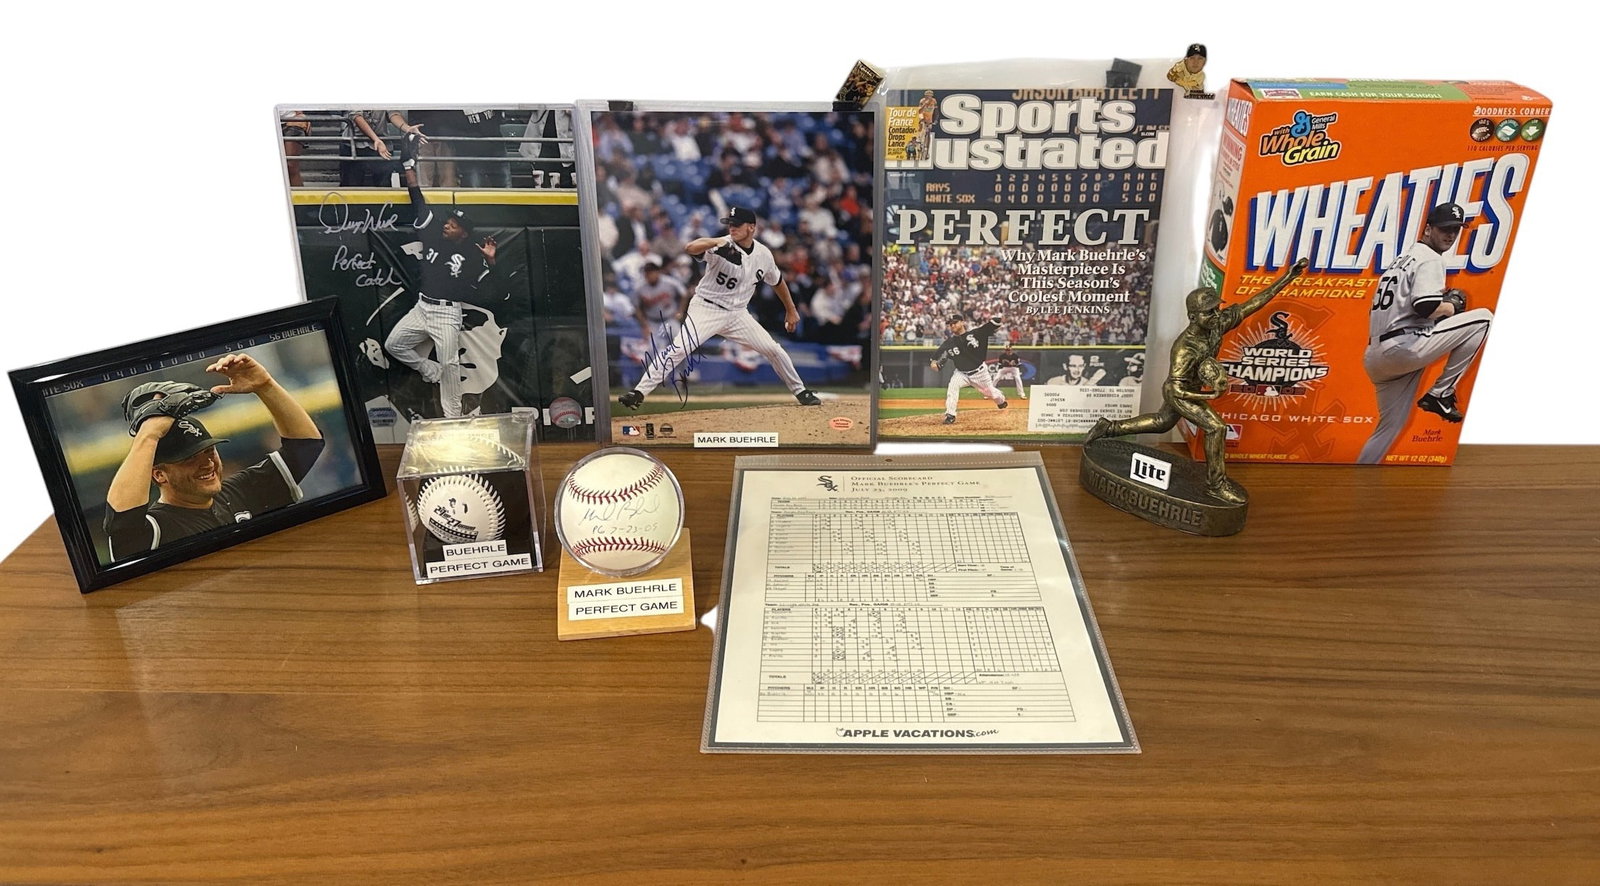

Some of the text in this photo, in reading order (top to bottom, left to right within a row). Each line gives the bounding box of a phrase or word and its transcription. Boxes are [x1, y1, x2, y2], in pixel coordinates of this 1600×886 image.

[889, 107, 917, 118] Tour de
[939, 93, 1137, 139] Sports
[1519, 107, 1551, 116] CORNER
[888, 117, 914, 127] France
[1311, 113, 1336, 124] General
[1273, 126, 1290, 136] with
[1311, 122, 1326, 130] Mills
[887, 134, 906, 142] Drops
[1261, 130, 1325, 154] Whole
[884, 131, 1170, 170] lustrated
[1283, 140, 1339, 164] Grain
[996, 173, 1158, 182] 1 2 3 4 5 6 7 8 9 R H E
[925, 182, 1157, 193] RAYS 0 0 0 0 0 0 0 0 0 0 0
[925, 193, 1156, 204] WHITE SOX 0 4 0 0 1 0 0 0 5 6 0
[895, 208, 1150, 246] PERFECT
[426, 247, 439, 264] 31
[1000, 249, 1147, 264] Why Mark Buehrle's
[1017, 263, 1126, 277] Masterpiece Is
[715, 271, 739, 290] 56
[1020, 277, 1120, 289] This Season's
[1241, 274, 1378, 289] THE REAKFAST
[1008, 290, 1131, 303] Coolest Moment
[1236, 286, 1368, 299] OF HAMPIONS
[1026, 305, 1110, 316] By LEE JENKINS
[1243, 347, 1313, 359] WORLD
[1241, 356, 1311, 367] SERIES
[1219, 412, 1374, 424] HICAGO WHITE SOX
[1423, 428, 1442, 436] Mark
[697, 435, 777, 444] MARK BUEHRLE
[1411, 434, 1443, 443] Buehrle
[1386, 454, 1398, 462] NET
[1399, 454, 1410, 462] WT
[1418, 455, 1428, 463] OZ
[1132, 458, 1166, 480] Lite
[1088, 470, 1203, 527] MARK BUEHRLE
[446, 544, 506, 557] BUEHRLE
[430, 557, 530, 574] PERFECT GAME
[574, 583, 678, 599] MARK BUEHRLE
[575, 600, 678, 616] PERFECT GAME
[842, 728, 890, 738] APPLE
